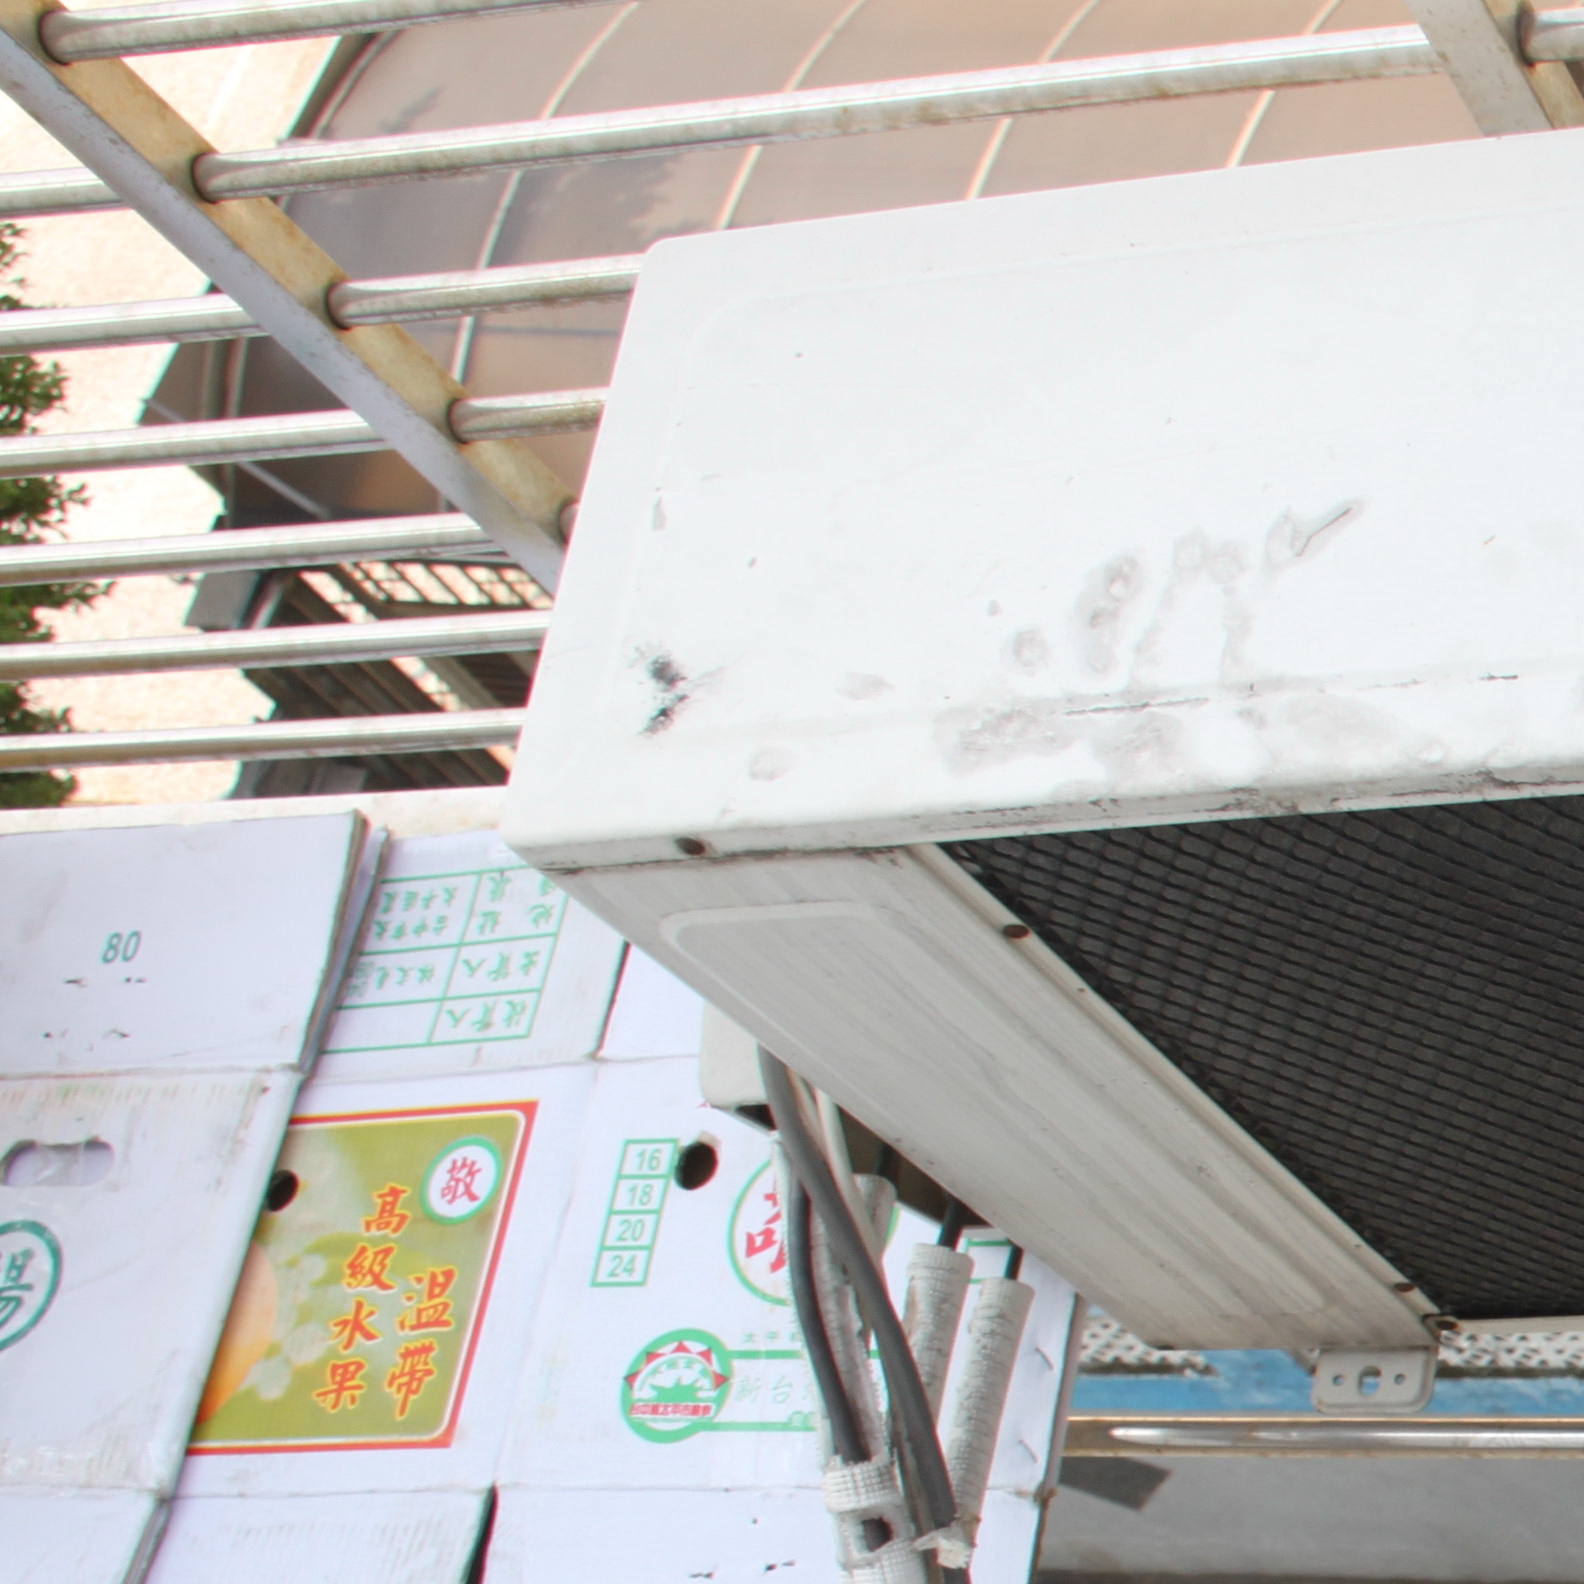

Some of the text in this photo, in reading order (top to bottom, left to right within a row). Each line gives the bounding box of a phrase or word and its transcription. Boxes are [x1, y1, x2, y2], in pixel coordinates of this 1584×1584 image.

[101, 930, 142, 964] 80
[636, 1147, 662, 1172] 16
[440, 1156, 483, 1206] 敬
[626, 1183, 652, 1207] 18
[615, 1218, 646, 1243] 20
[606, 1254, 637, 1279] 24
[312, 1182, 412, 1412] 高級水果
